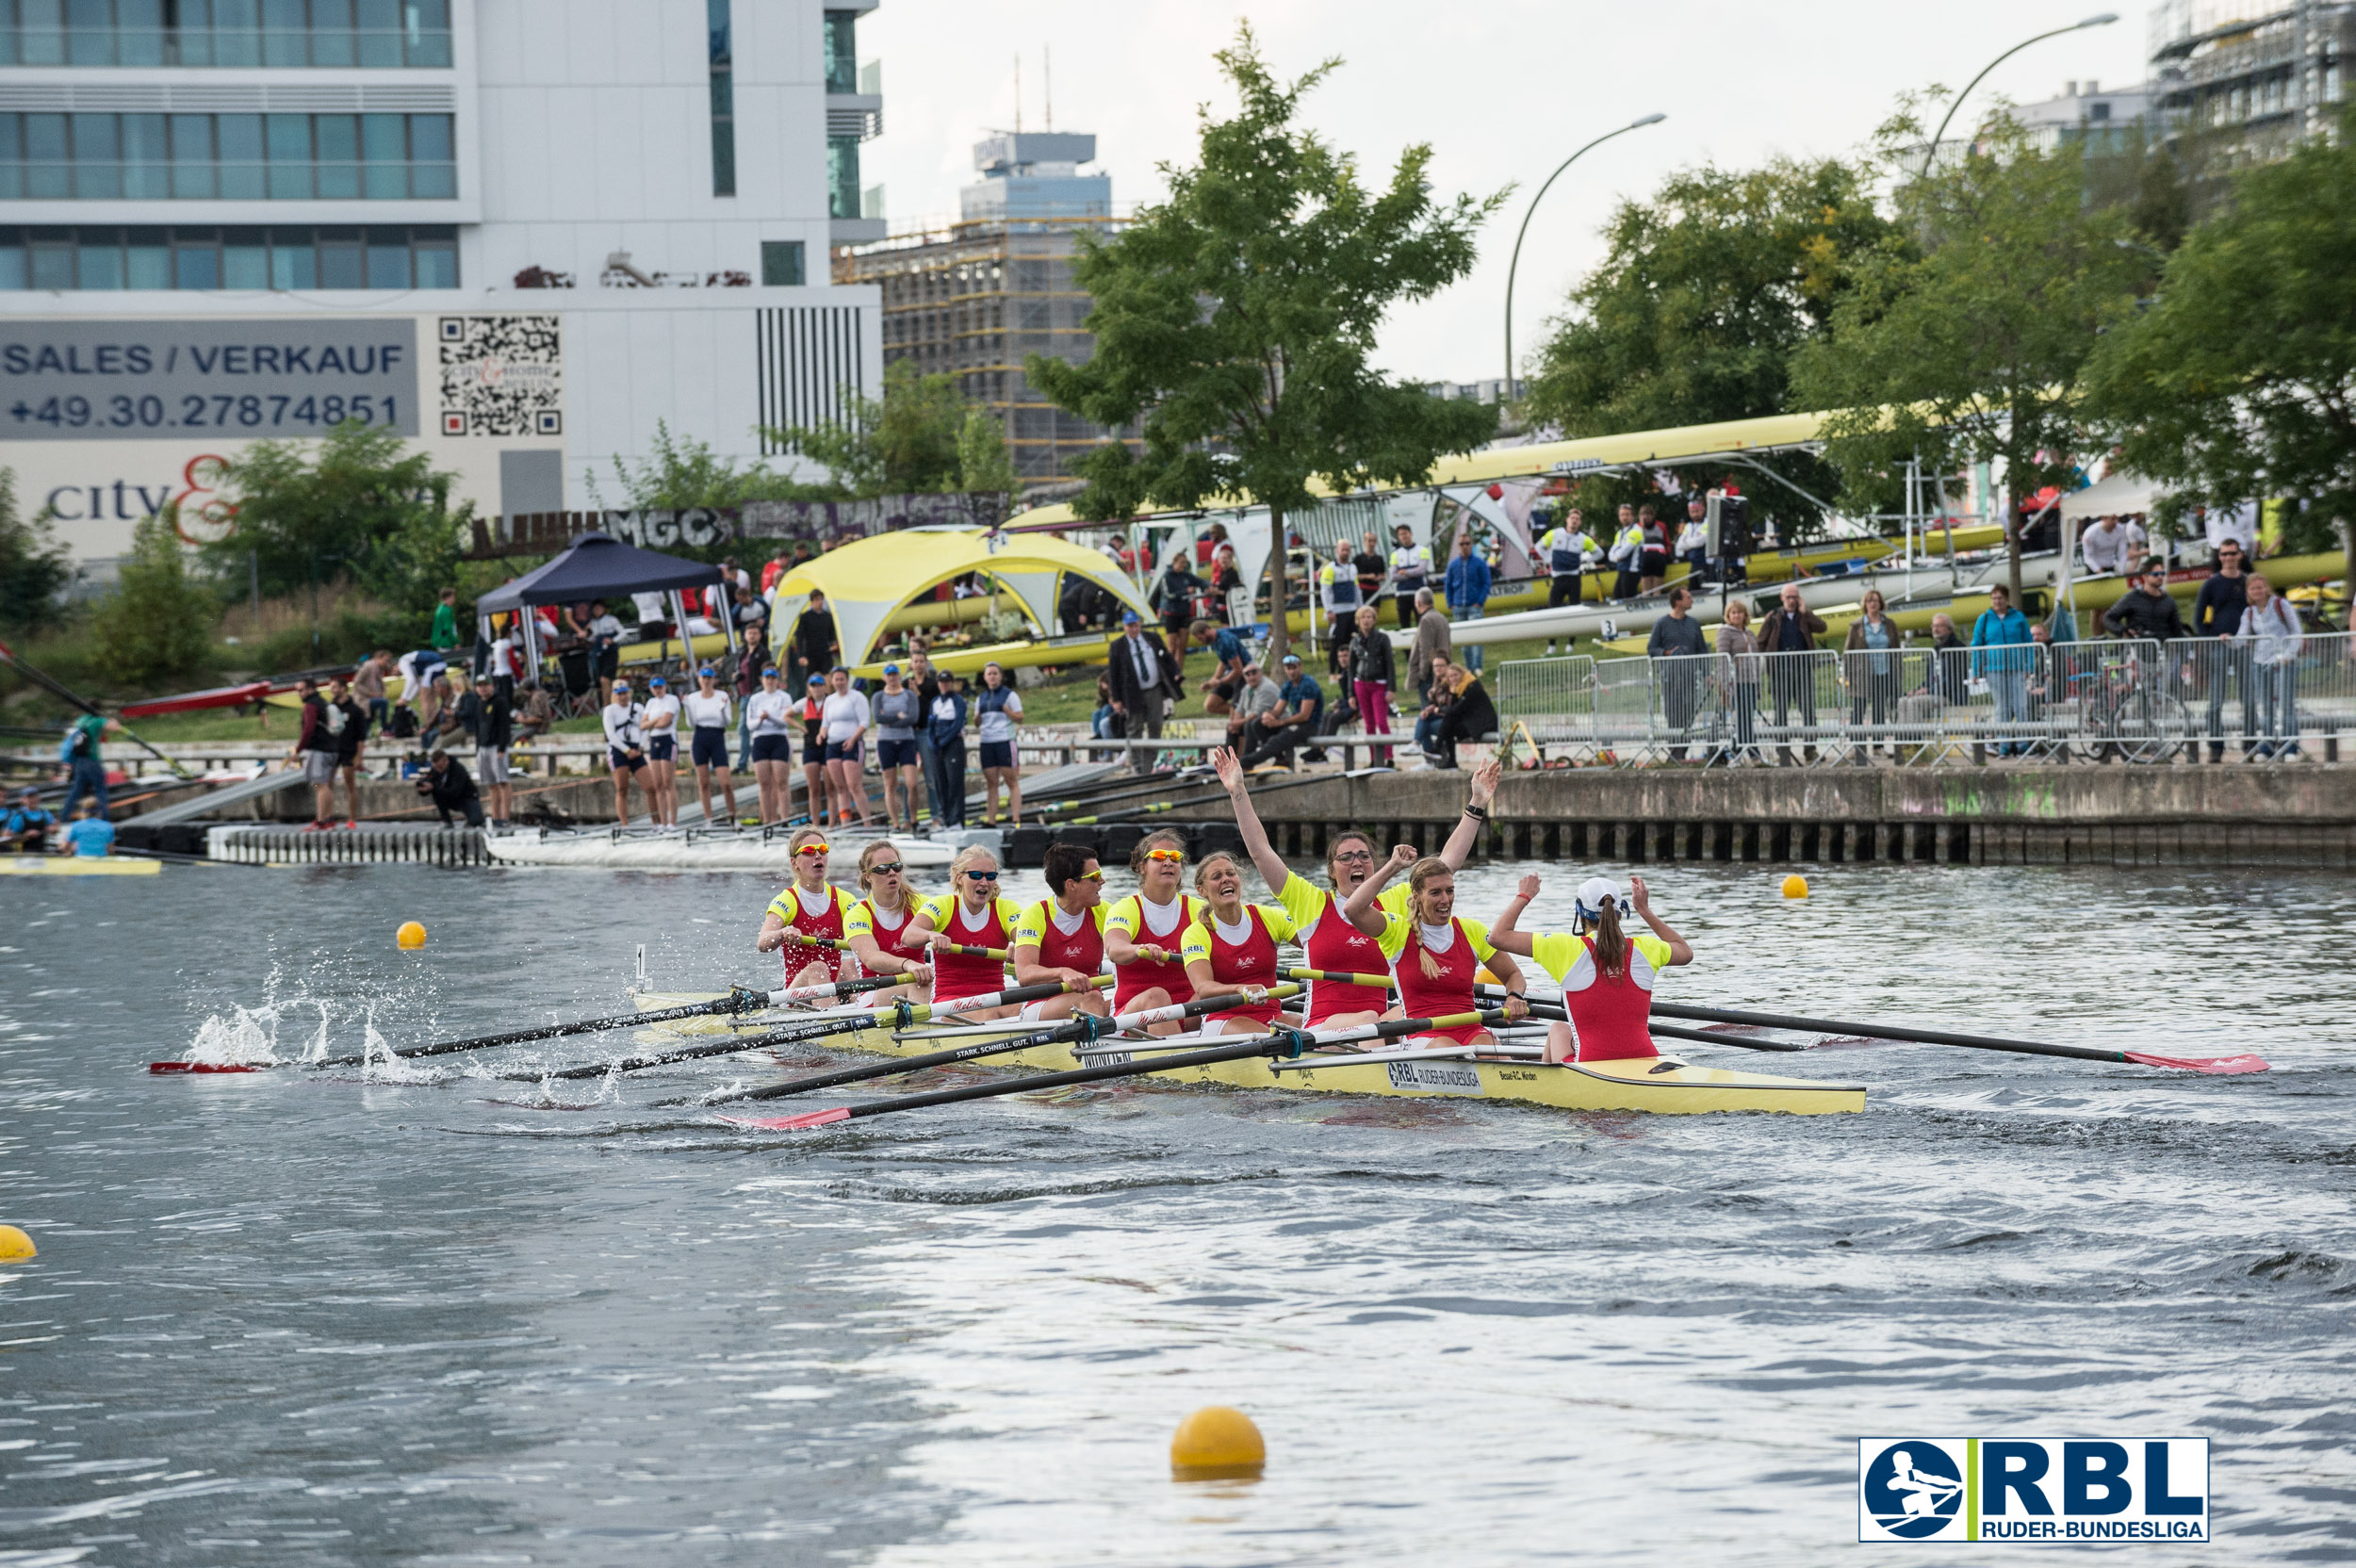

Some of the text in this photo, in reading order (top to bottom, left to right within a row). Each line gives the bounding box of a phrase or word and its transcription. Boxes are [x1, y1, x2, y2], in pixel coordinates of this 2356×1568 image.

[3, 344, 403, 375] SALES / VERKAUF
[9, 394, 398, 428] +49.30.27874851
[1605, 620, 1613, 634] 3
[776, 900, 790, 914] RBL
[928, 903, 941, 917] RBL
[1113, 916, 1129, 925] RBL
[1187, 945, 1204, 954] RBL
[787, 988, 819, 1003] Melitta
[951, 998, 984, 1011] Melitta
[1136, 1012, 1168, 1026] Melitta
[776, 1031, 799, 1040] STARK.
[800, 1025, 832, 1037] SCHNELL.
[956, 1047, 980, 1058] STARK.
[980, 1040, 1012, 1054] SCHNELL.
[1012, 1037, 1029, 1049] GUT.
[1037, 1034, 1050, 1042] RBL
[1397, 1063, 1481, 1087] RBL RUDER-BUNDESLIGA
